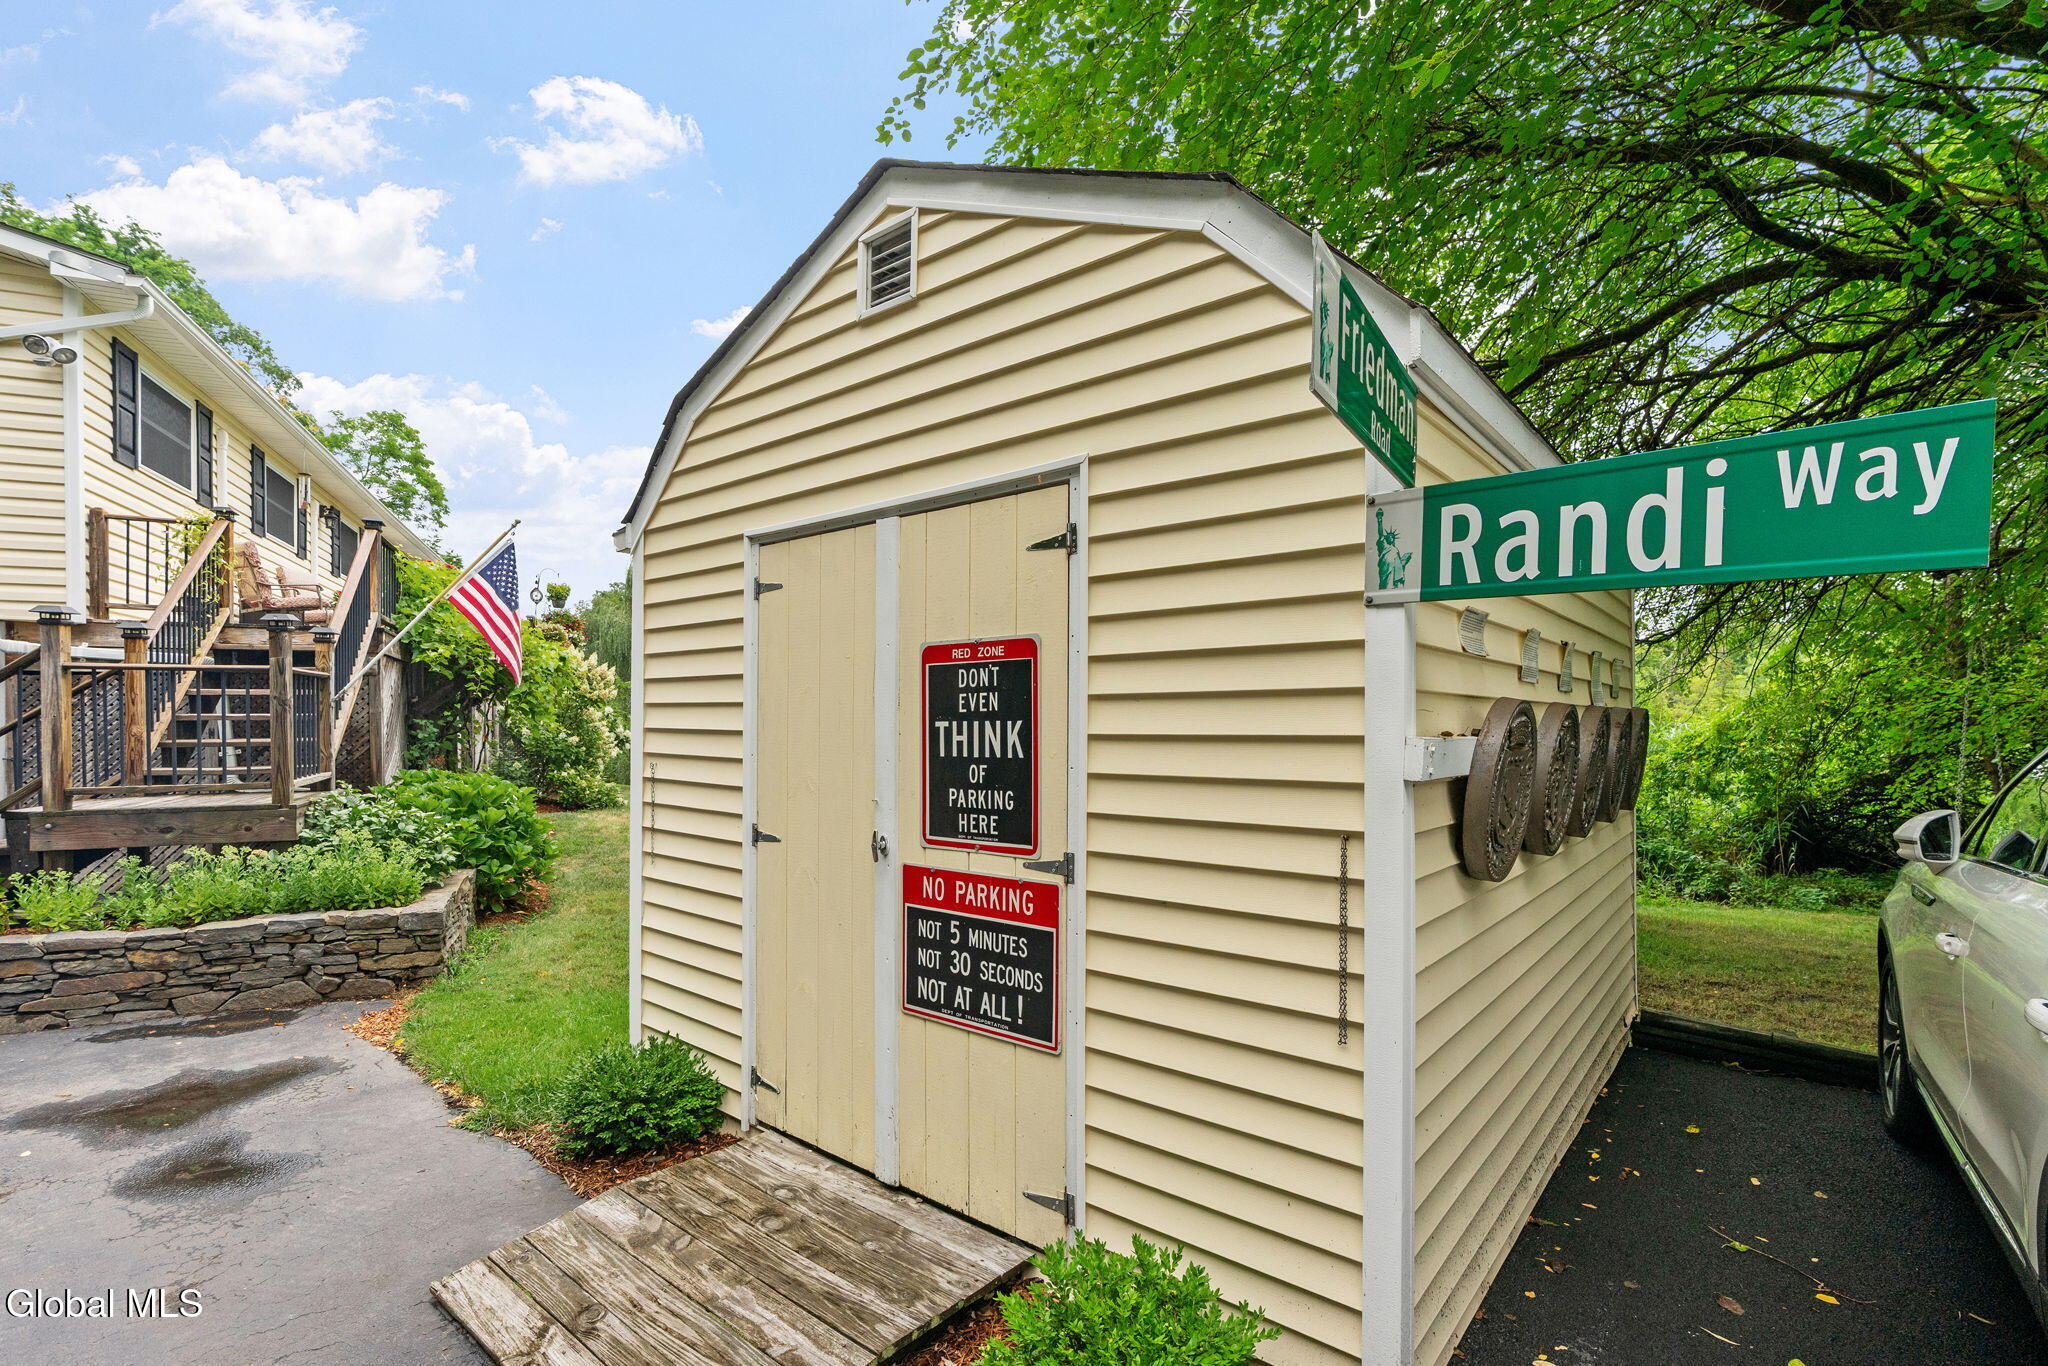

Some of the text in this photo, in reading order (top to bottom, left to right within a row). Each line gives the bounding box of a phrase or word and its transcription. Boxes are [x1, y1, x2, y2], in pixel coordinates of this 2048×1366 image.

[1341, 293, 1414, 447] Friedman
[1371, 410, 1391, 459] Road
[1438, 436, 1961, 587] Randi Way
[952, 645, 1005, 659] RED ZONE
[958, 664, 999, 688] DON'T
[958, 691, 999, 713] EVEN
[935, 719, 1024, 759] THINK
[969, 764, 988, 784] OF
[949, 788, 1014, 811] PARKING
[958, 813, 999, 835] HERE
[922, 875, 1034, 916] NO PARKING
[918, 918, 1028, 958] NOT 5 MINUTES
[918, 947, 1043, 993] NOT 30 SECONDS
[917, 975, 947, 1005] NOT
[954, 985, 973, 1011] AT
[965, 1014, 1009, 1031] TRANSPORTATION
